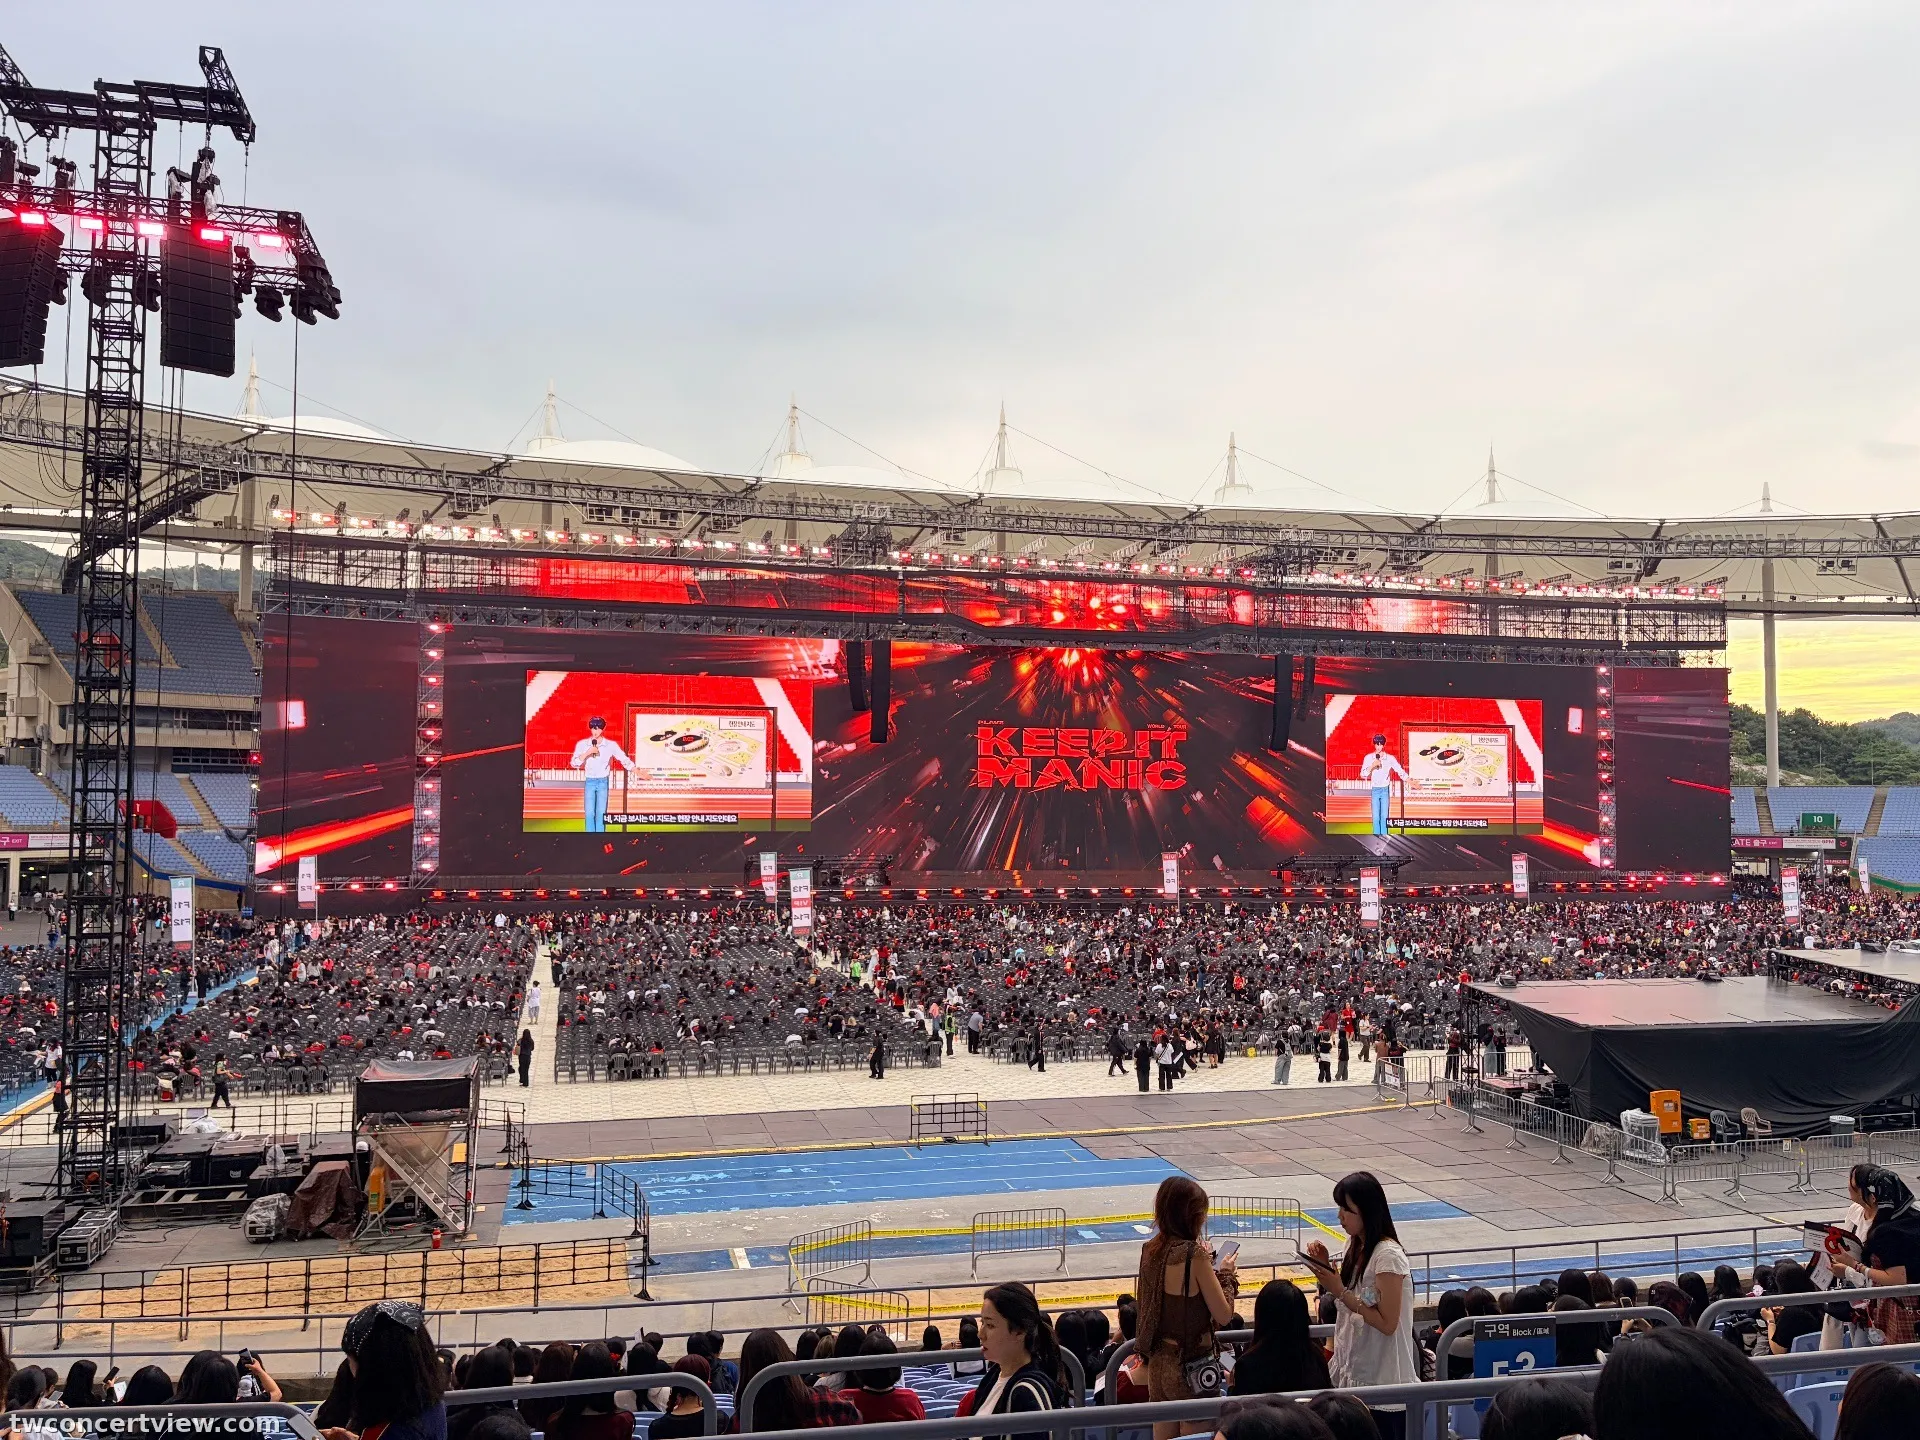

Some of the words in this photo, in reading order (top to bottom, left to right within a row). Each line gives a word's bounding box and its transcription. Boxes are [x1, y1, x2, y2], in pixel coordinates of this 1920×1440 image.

[977, 727, 1128, 758] KEEP
[1134, 729, 1187, 759] IT
[976, 757, 1187, 790] MANIC
[613, 815, 627, 823] 지금
[628, 815, 648, 823] 보시는
[649, 815, 656, 823] 이
[657, 815, 676, 823] 지도는
[677, 814, 690, 823] 현장
[691, 815, 705, 823] 안내
[705, 815, 737, 823] 지도인데요
[1813, 815, 1823, 823] 10
[1484, 1323, 1510, 1337] 구역
[1512, 1327, 1532, 1337] Block
